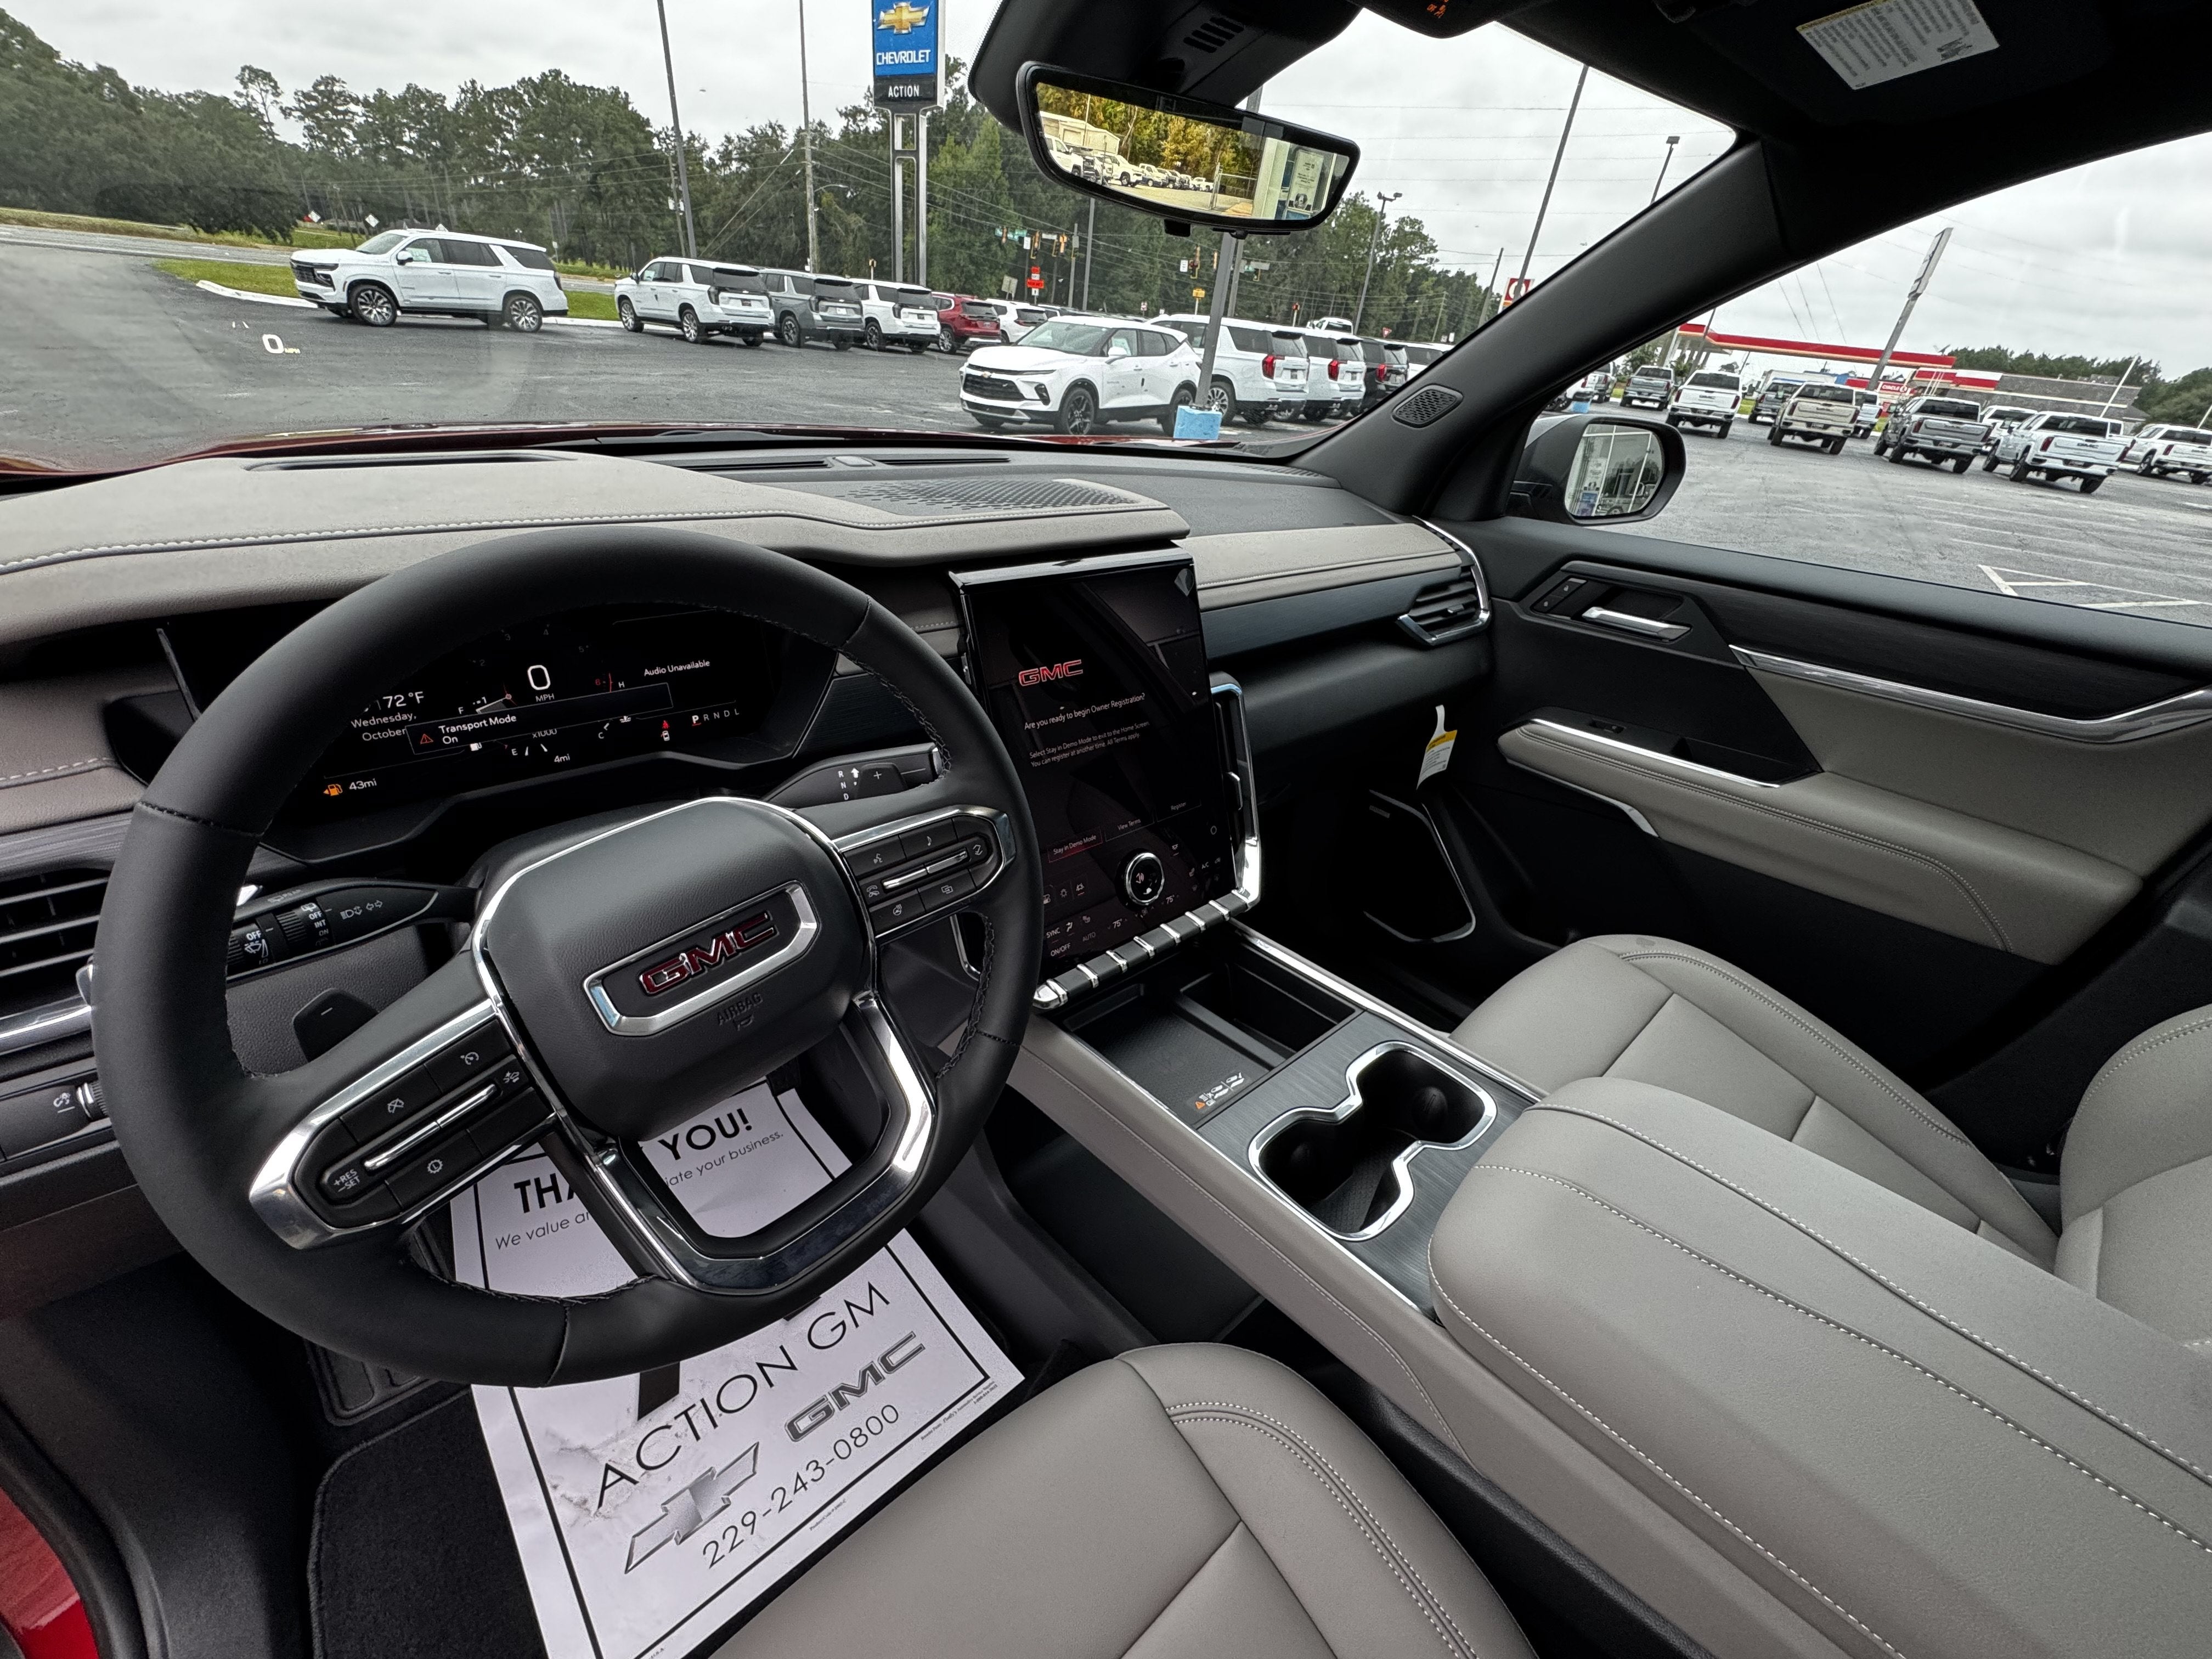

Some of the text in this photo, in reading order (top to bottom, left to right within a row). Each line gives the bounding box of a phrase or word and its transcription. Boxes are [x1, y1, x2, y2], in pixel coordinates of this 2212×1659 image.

[876, 49, 931, 65] CHEVROLET
[888, 84, 919, 98] ACTION
[262, 334, 284, 354] 0
[644, 659, 710, 676] Audio Unavailable
[1018, 659, 1084, 686] GMC
[527, 664, 551, 690] 0
[535, 693, 555, 703] MPH
[458, 706, 464, 714] F
[1024, 722, 1036, 730] Are
[1036, 718, 1048, 729] you
[1049, 713, 1066, 724] ready
[1074, 707, 1091, 718] begin
[1091, 703, 1110, 713] Owner
[1110, 692, 1146, 708] Registration?
[351, 712, 416, 729] Wednesday,
[438, 714, 517, 733] Transport Mode
[692, 715, 699, 724] P
[362, 728, 407, 741] October
[442, 736, 458, 744] On
[1029, 751, 1046, 759] Select
[1046, 747, 1057, 755] Stay
[1063, 741, 1078, 750] Demo
[1078, 737, 1092, 746] Mode
[1120, 725, 1135, 733] Home
[1052, 752, 1070, 763] register
[1076, 745, 1095, 755] another
[1095, 742, 1107, 750] time.
[1113, 736, 1127, 744] Terms
[1127, 732, 1141, 741] apply.
[554, 753, 571, 763] 4mi
[349, 777, 377, 791] 43mi
[1170, 802, 1187, 811] Register
[1127, 818, 1141, 827] Terms
[1053, 847, 1064, 855] Stay
[1069, 840, 1083, 849] Demo
[1083, 834, 1097, 843] Mode
[308, 911, 323, 920] OFF
[314, 919, 326, 928] INT
[246, 930, 262, 941] OFF
[319, 928, 329, 937] ON
[1046, 927, 1061, 939] SYNC
[1082, 932, 1096, 943] AUTO
[638, 911, 780, 997] GMC
[1050, 942, 1071, 957] ON/OFF
[716, 992, 763, 1025] AIRBAG
[657, 1107, 752, 1160] YOU!
[495, 1233, 521, 1250] We
[526, 1219, 569, 1240] value
[696, 1155, 726, 1176] your
[728, 1131, 784, 1160] business.
[784, 1330, 926, 1442] GMC
[596, 1281, 890, 1511] ACTION GM
[702, 1404, 899, 1570] 229-243-0800
